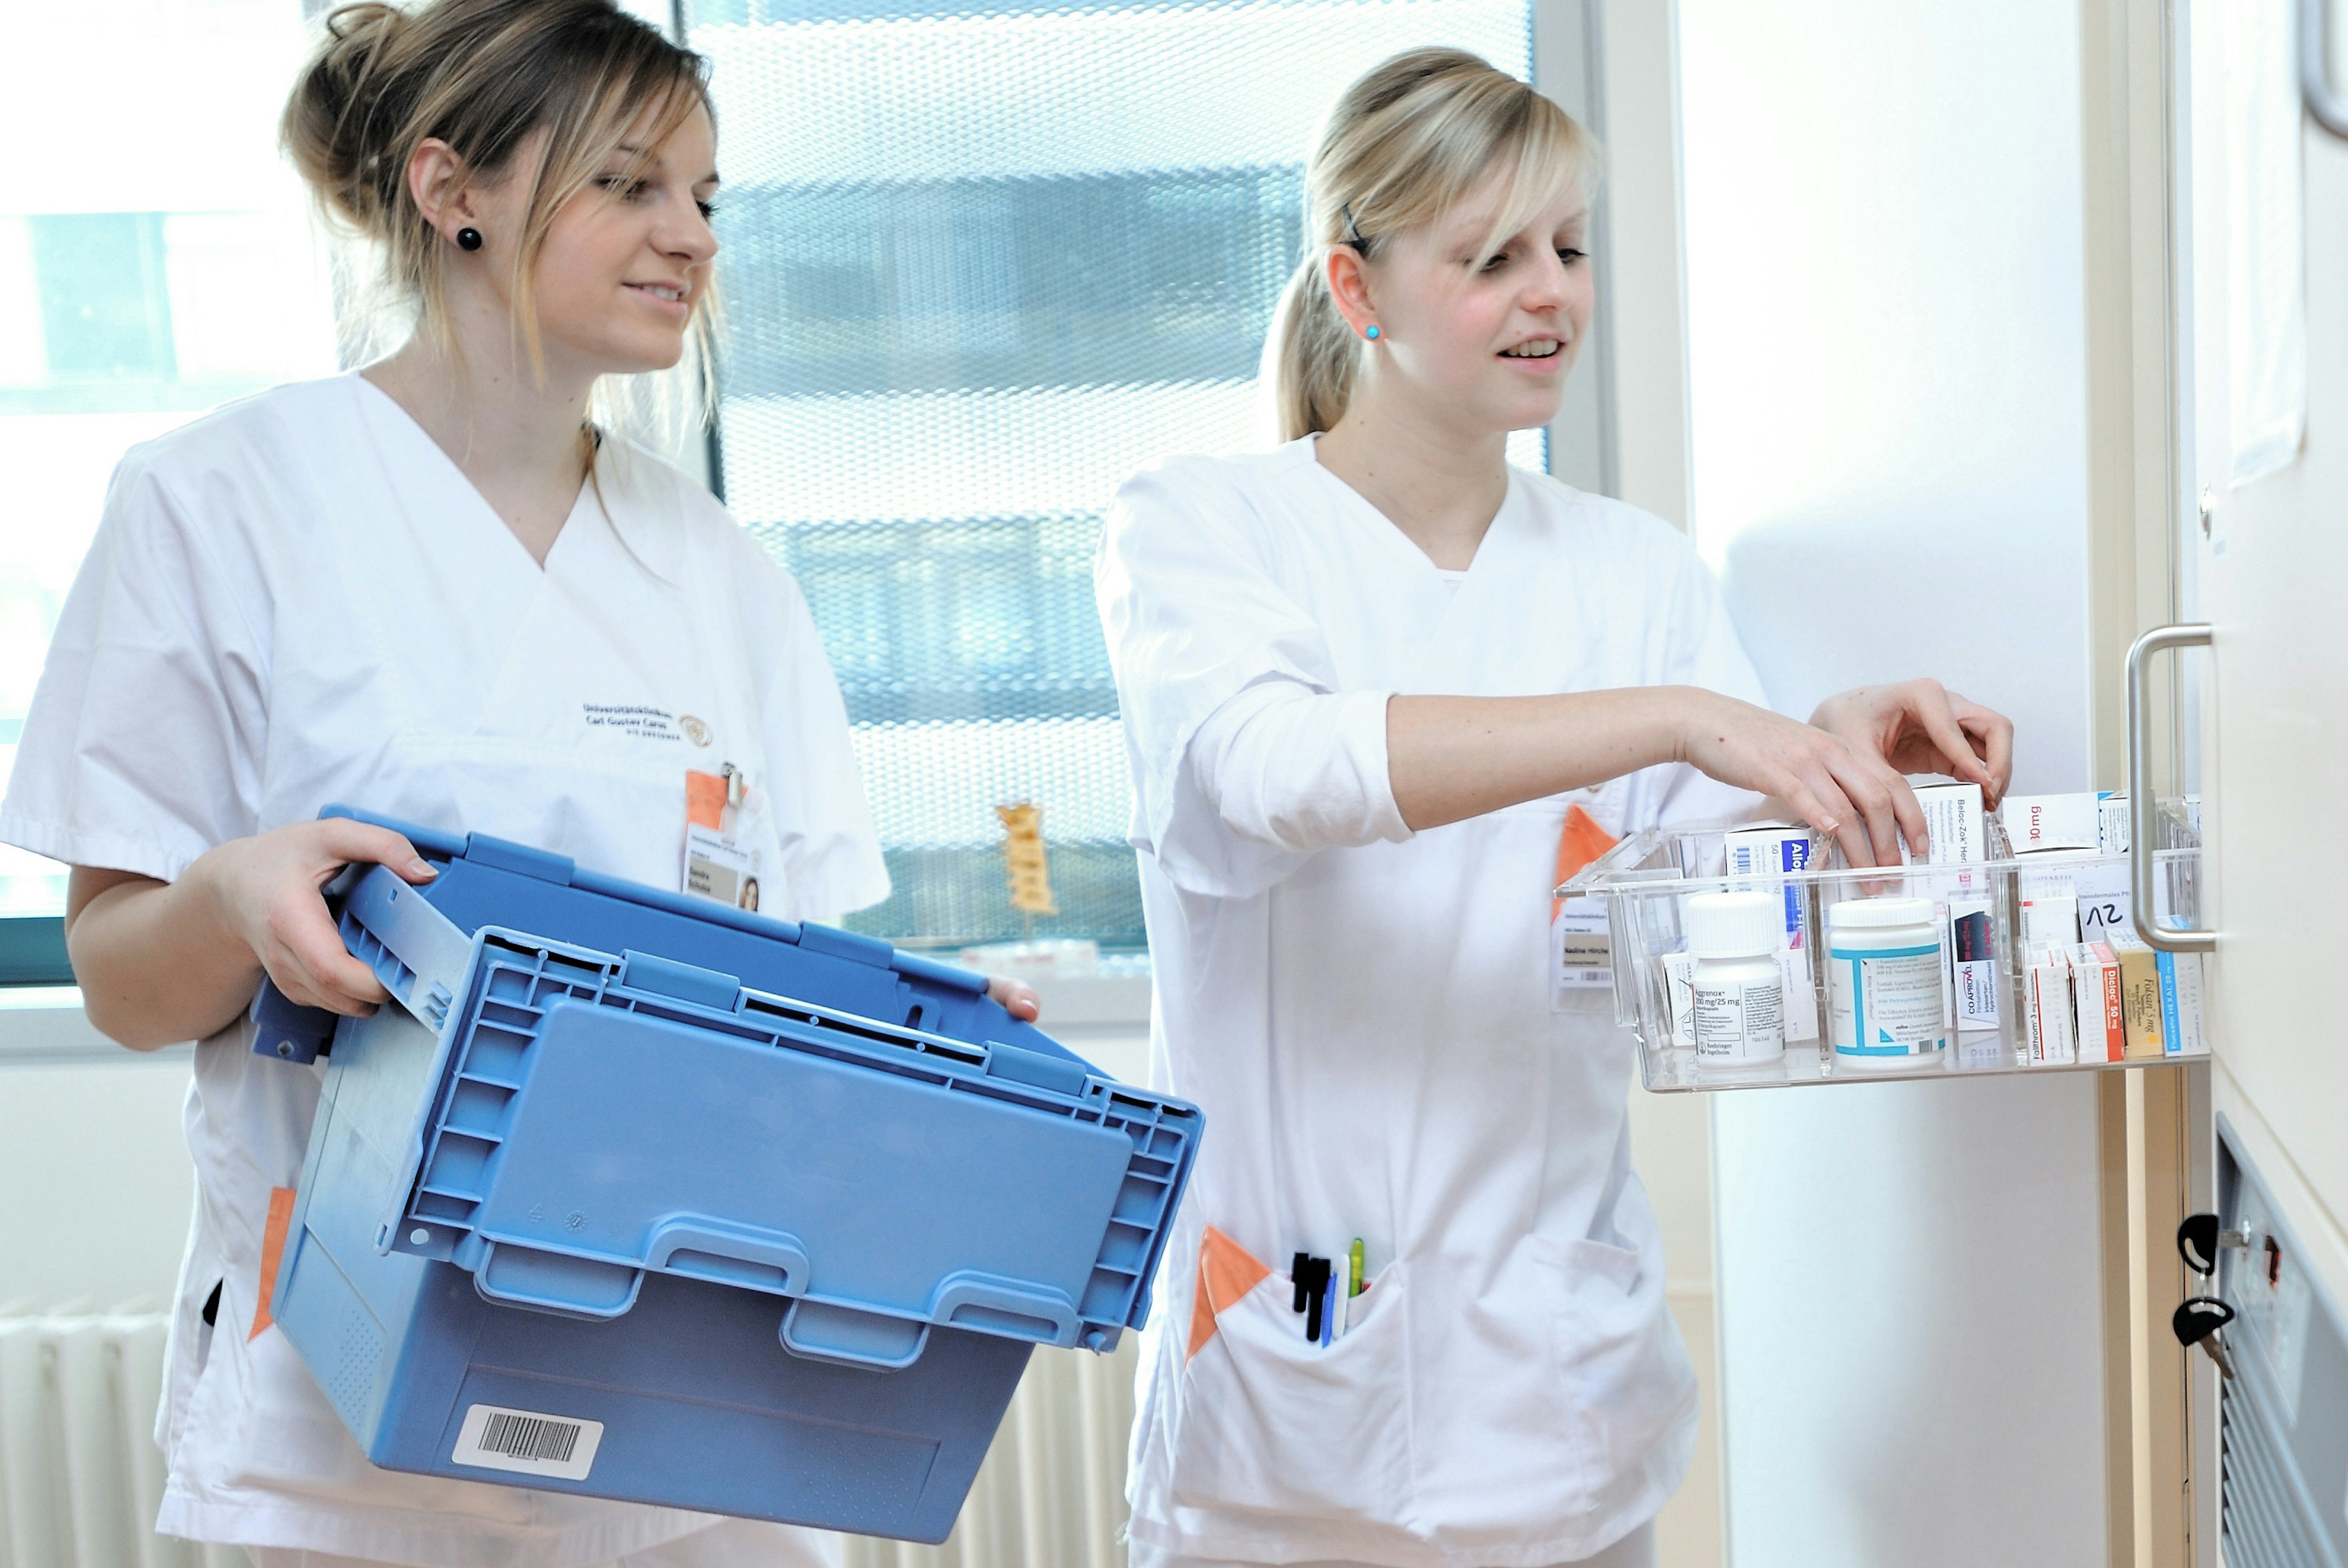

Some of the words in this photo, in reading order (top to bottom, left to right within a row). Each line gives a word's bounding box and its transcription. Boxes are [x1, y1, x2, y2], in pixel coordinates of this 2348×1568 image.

[586, 715, 604, 725] Carl
[607, 716, 640, 726] Gustav
[643, 717, 667, 730] Carus
[2110, 1005, 2118, 1017] 50
[2145, 1019, 2155, 1033] mg
